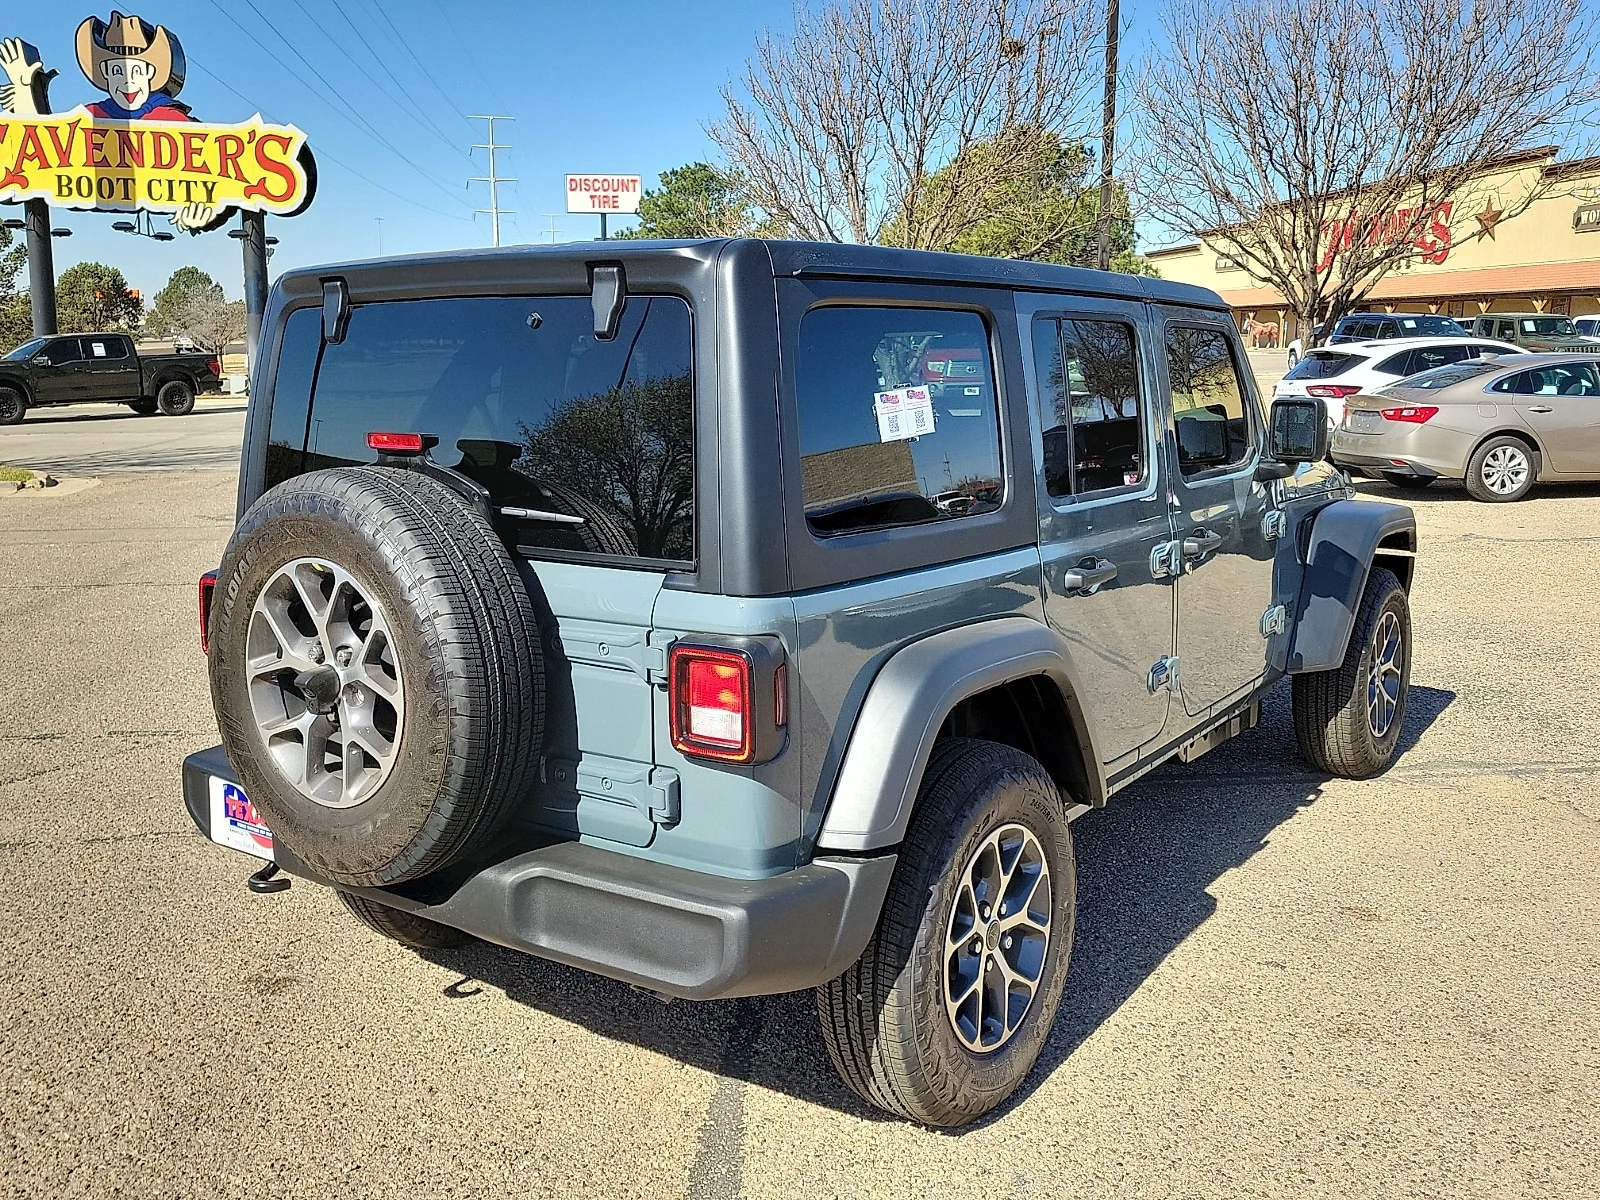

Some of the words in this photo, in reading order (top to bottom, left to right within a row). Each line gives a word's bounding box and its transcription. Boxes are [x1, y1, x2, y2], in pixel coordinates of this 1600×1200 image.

[55, 174, 136, 200] BOOT
[147, 178, 218, 203] CITY
[568, 178, 638, 192] DISCOUNT
[589, 195, 620, 208] TIRE
[1029, 798, 1056, 824] 245/75R17
